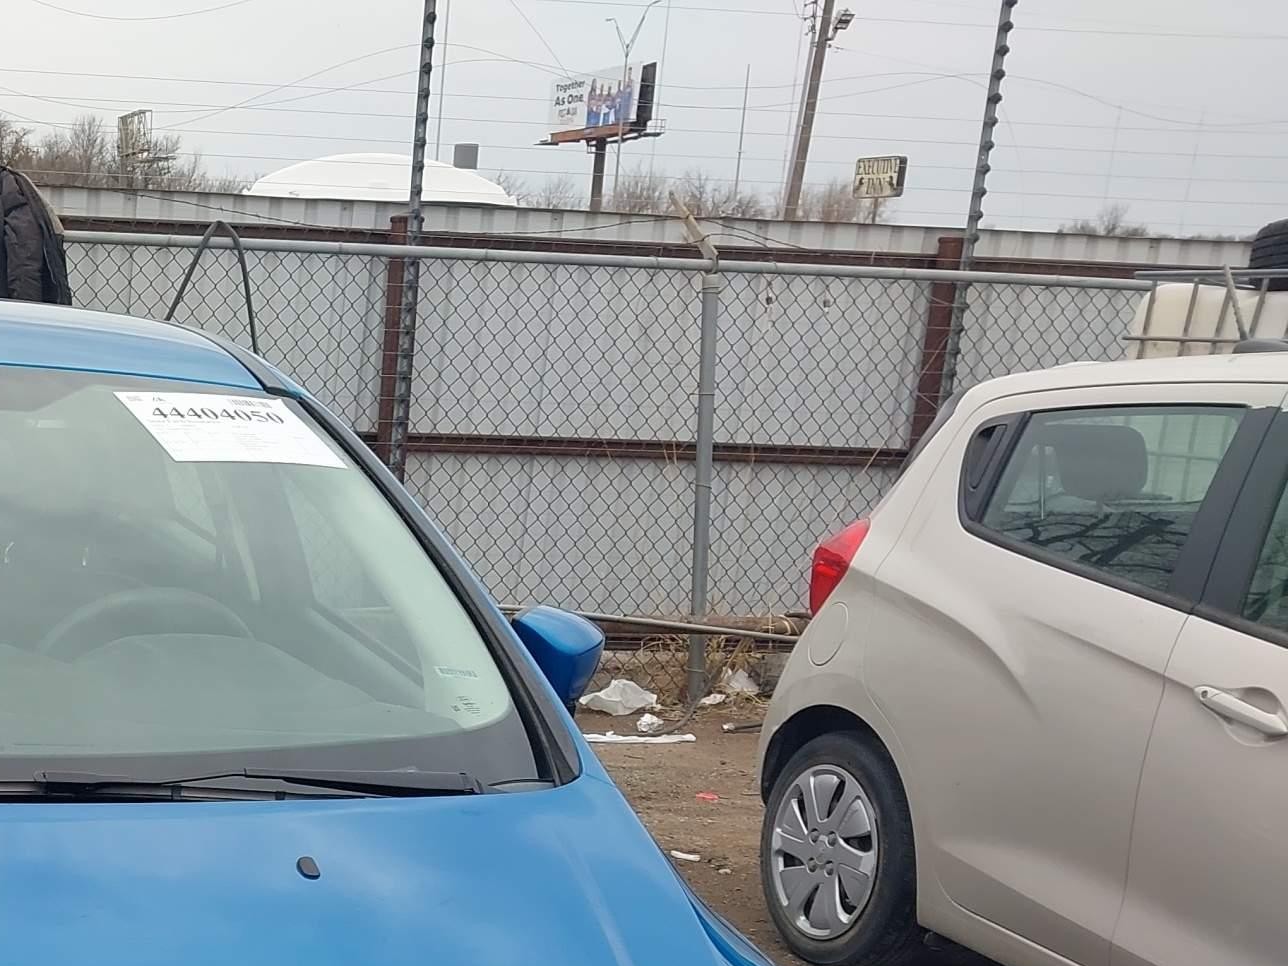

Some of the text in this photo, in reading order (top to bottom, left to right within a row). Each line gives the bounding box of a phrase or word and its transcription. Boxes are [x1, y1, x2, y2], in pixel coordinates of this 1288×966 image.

[555, 79, 585, 93] Together
[554, 93, 584, 107] As One
[855, 158, 898, 176] EXECUTIVE
[865, 176, 887, 195] INN
[152, 406, 285, 424] 44404050
